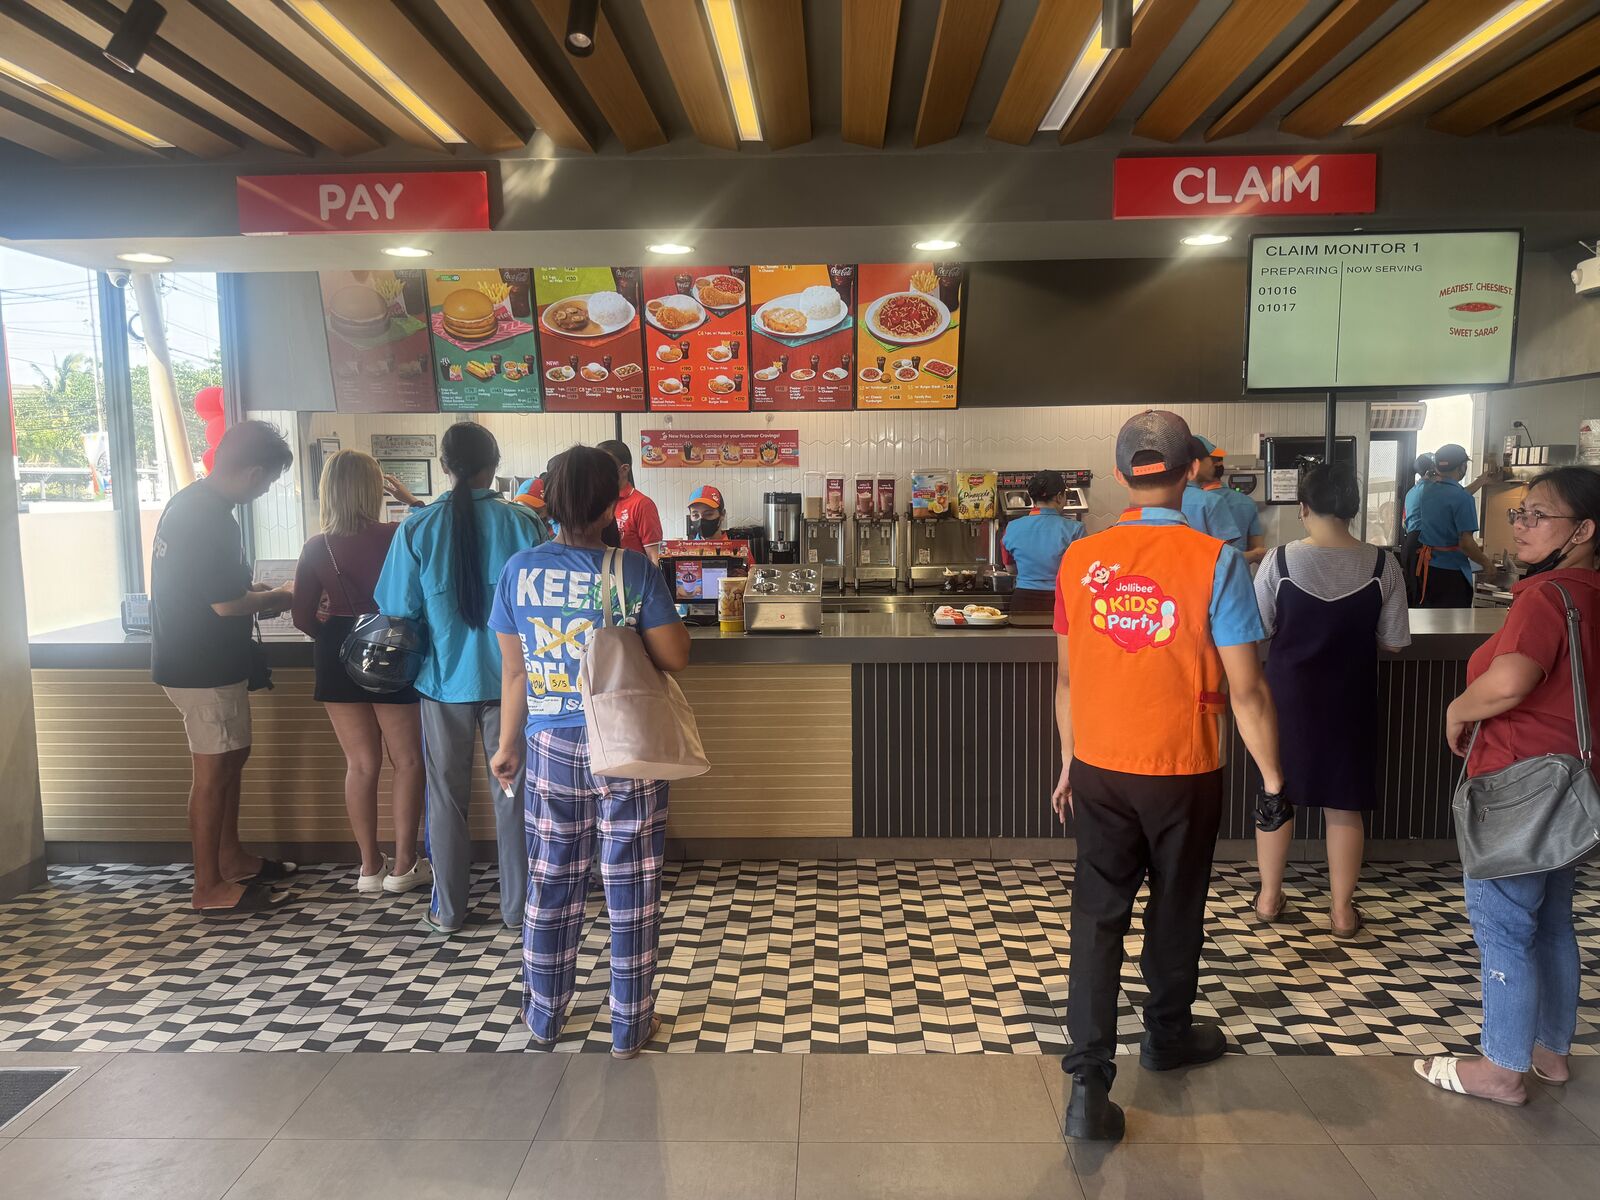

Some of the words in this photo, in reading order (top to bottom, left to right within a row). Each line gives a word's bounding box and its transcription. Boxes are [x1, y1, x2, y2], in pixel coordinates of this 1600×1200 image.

[1172, 165, 1320, 205] CLAIM
[318, 182, 404, 221] PAY
[1265, 244, 1319, 257] CLAIM
[1323, 243, 1407, 256] MONITOR
[1413, 242, 1420, 253] 1
[1260, 265, 1339, 276] PREPARING
[1346, 265, 1372, 274] NOW
[1375, 264, 1423, 273] SERVING
[1258, 286, 1297, 296] 01016
[1439, 283, 1474, 298] MEATIEST.
[1475, 282, 1513, 296] CHEESIEST.
[1257, 303, 1296, 313] 01017
[1449, 326, 1473, 338] SWEET
[1473, 325, 1499, 338] SARAP
[1116, 582, 1153, 593] Jollibee
[1107, 614, 1161, 636] Party
[552, 679, 567, 688] 5/5
